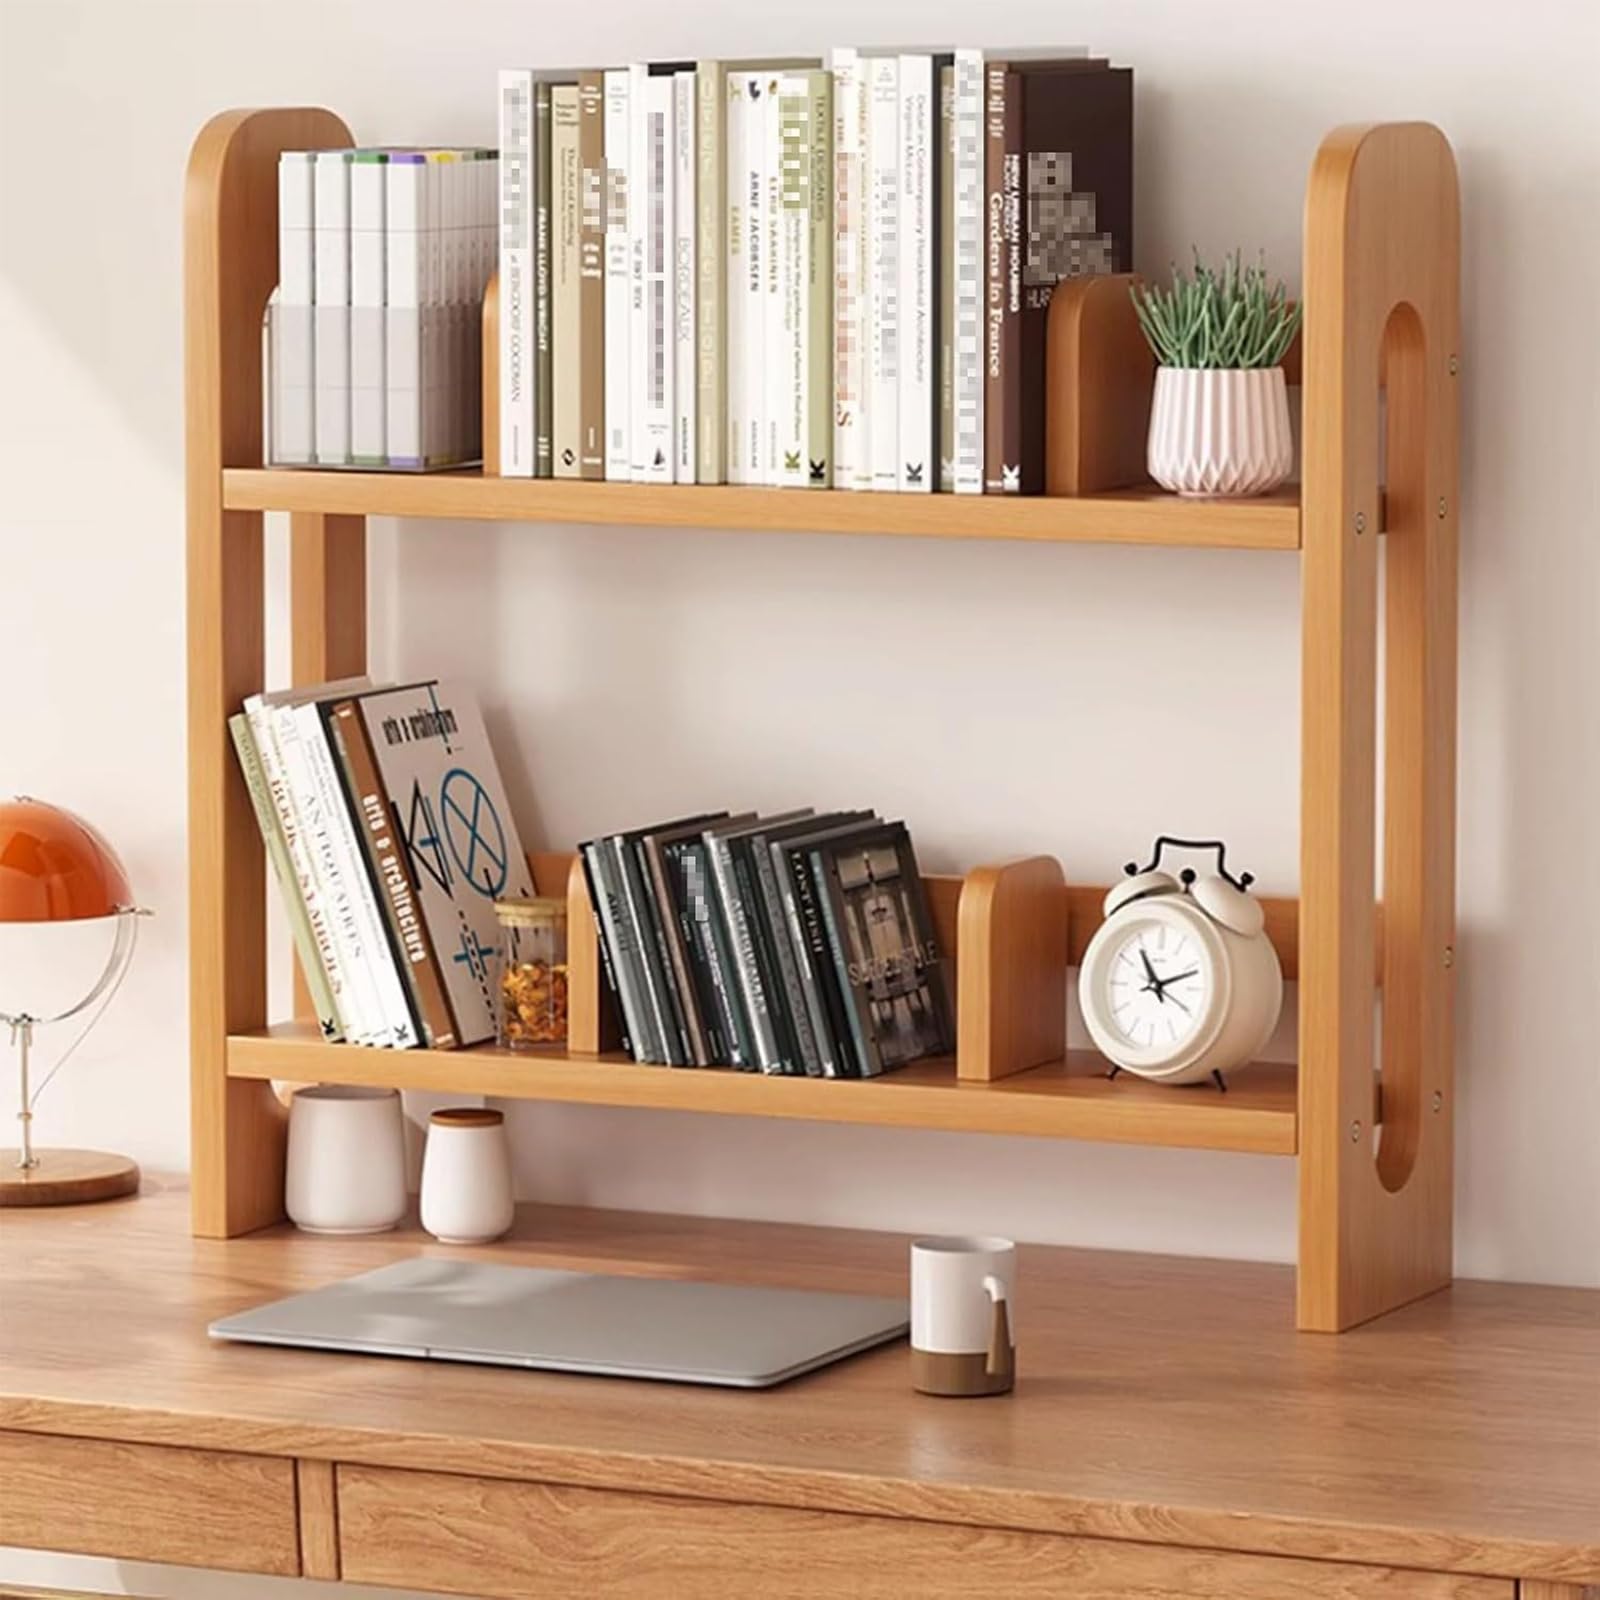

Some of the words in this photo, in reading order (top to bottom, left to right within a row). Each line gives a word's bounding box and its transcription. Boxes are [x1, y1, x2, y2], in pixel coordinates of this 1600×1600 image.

[750, 171, 760, 208] ARNE
[1010, 154, 1021, 189] NEW
[537, 207, 548, 251] FRANK
[989, 191, 1004, 278] Gardens
[1010, 190, 1021, 243] URBAN
[537, 253, 548, 296] LLOYD
[749, 215, 761, 292] JACOBSEN
[678, 238, 691, 343] BORDEAUX
[989, 281, 1004, 303] in
[537, 299, 549, 352] WRIGHT
[989, 306, 1004, 378] France
[381, 855, 427, 963] architecture
